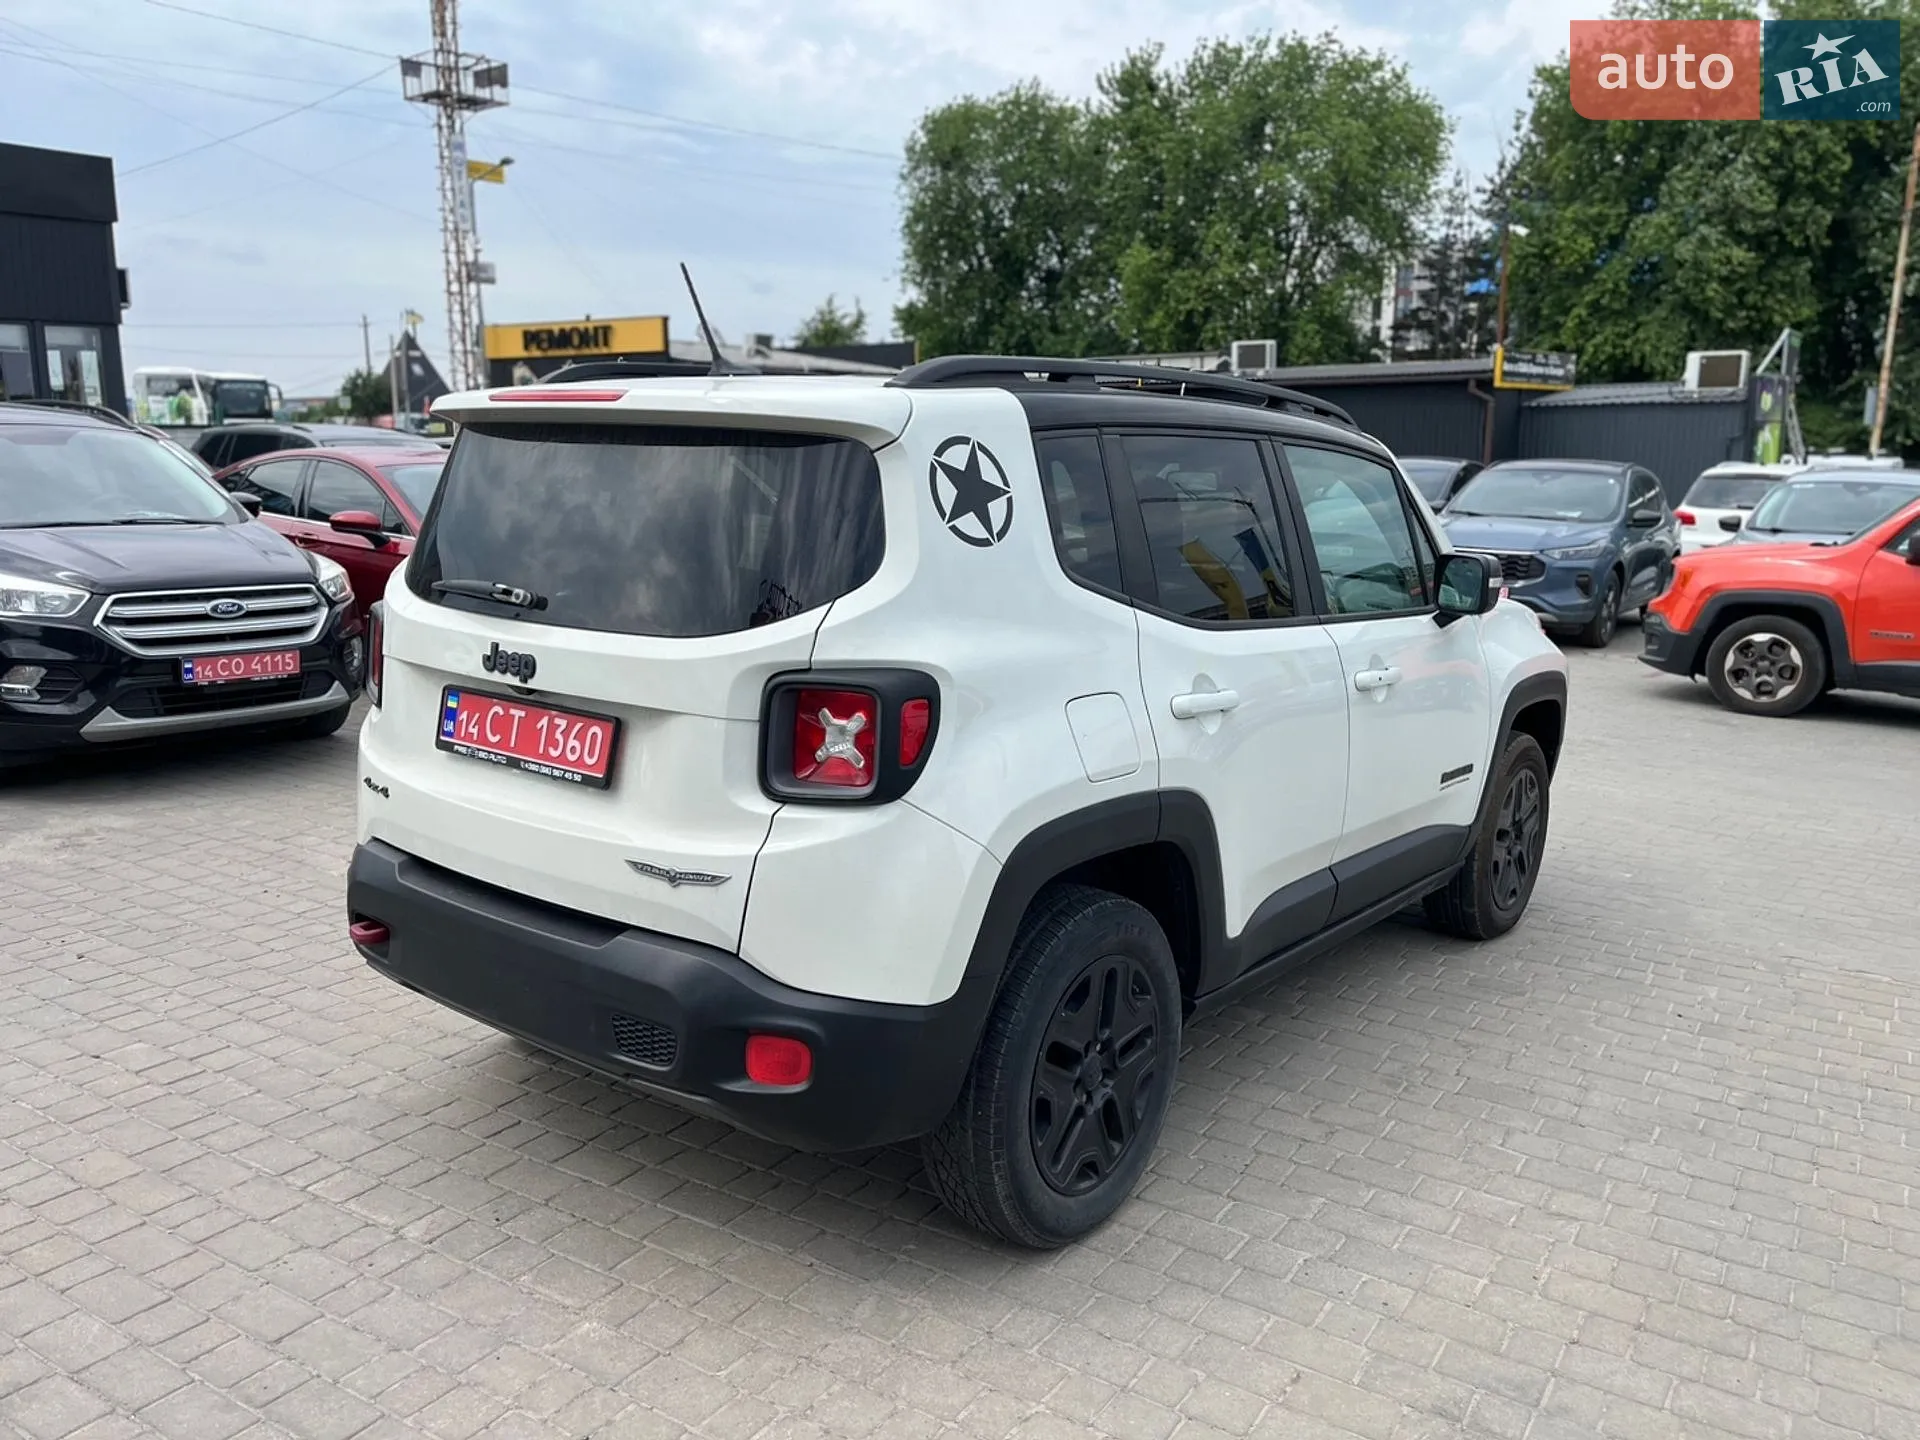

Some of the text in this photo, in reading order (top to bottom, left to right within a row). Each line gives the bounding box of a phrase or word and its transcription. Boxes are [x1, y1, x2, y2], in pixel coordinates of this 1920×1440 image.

[522, 325, 612, 351] РЕМОНТ
[251, 653, 294, 673] 4115
[482, 641, 536, 684] Jeep
[443, 718, 455, 733] UA
[536, 715, 603, 766] 1360
